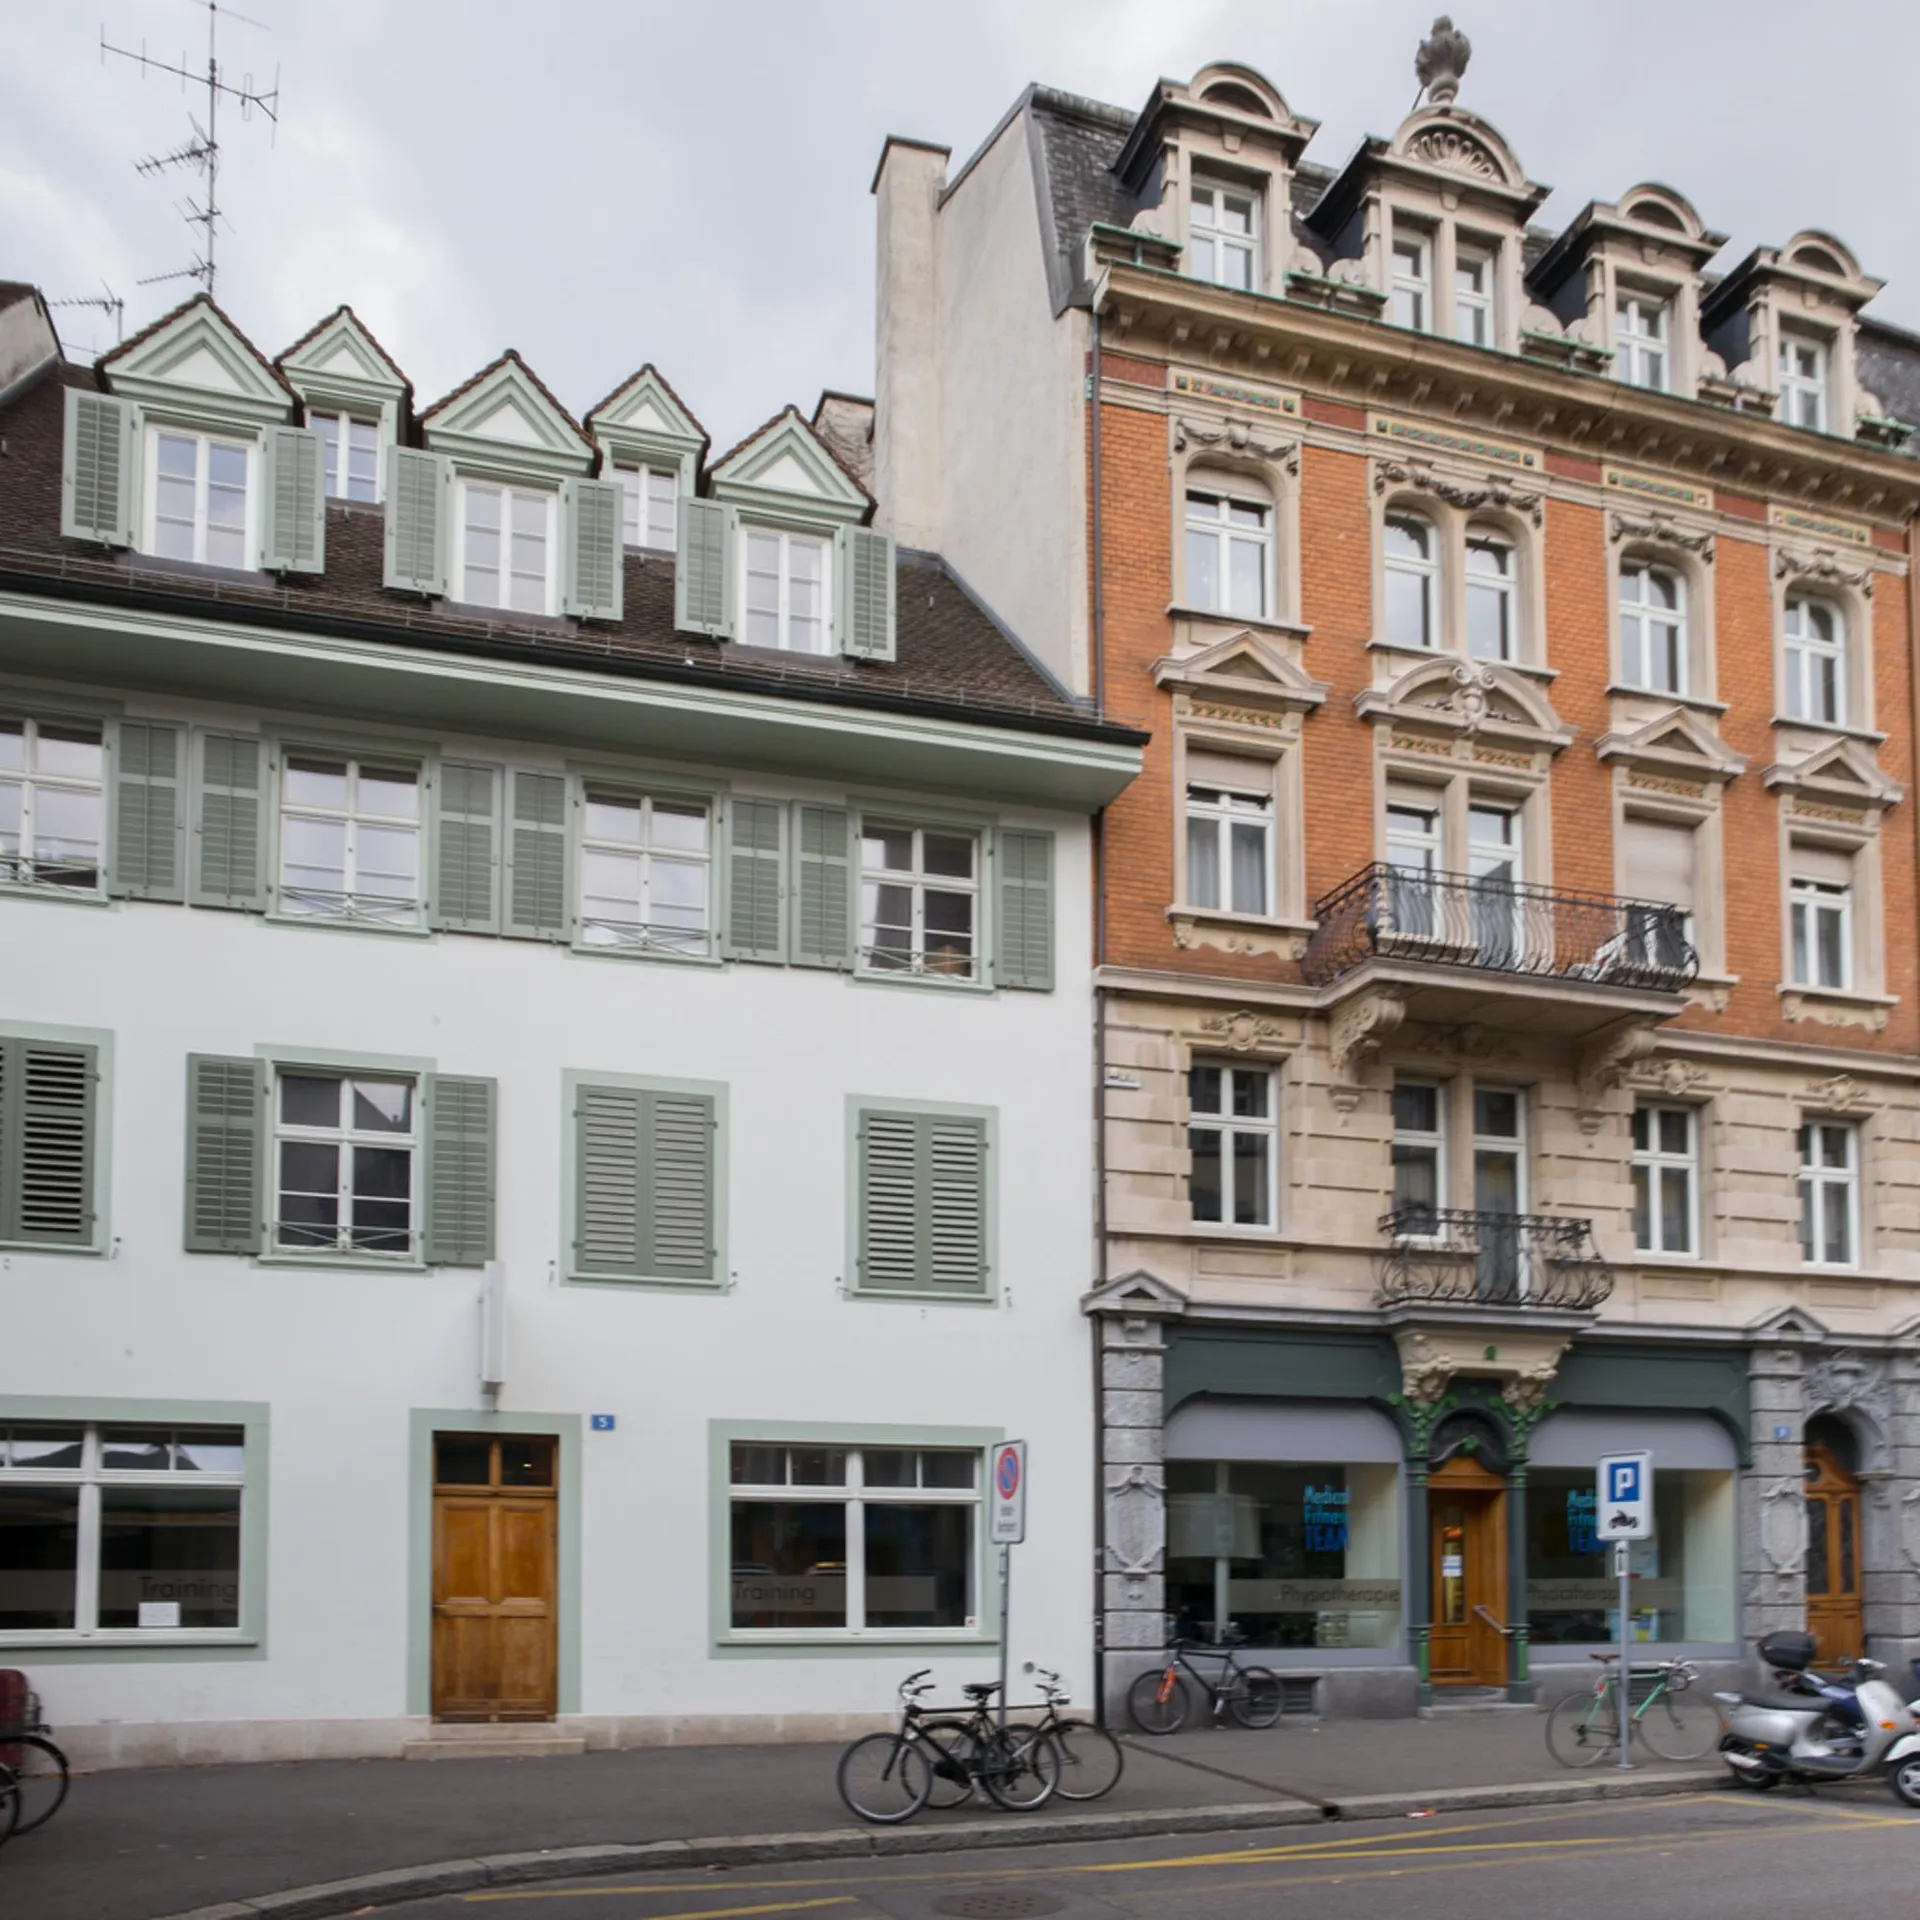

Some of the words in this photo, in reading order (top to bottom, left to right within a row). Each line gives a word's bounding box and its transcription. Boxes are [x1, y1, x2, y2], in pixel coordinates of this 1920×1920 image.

[599, 1416, 608, 1428] 5
[1303, 1484, 1351, 1505] Medical
[1615, 1467, 1635, 1499] P
[137, 1576, 238, 1604] Training
[731, 1580, 817, 1606] Training
[1280, 1583, 1400, 1607] Physiotherapie
